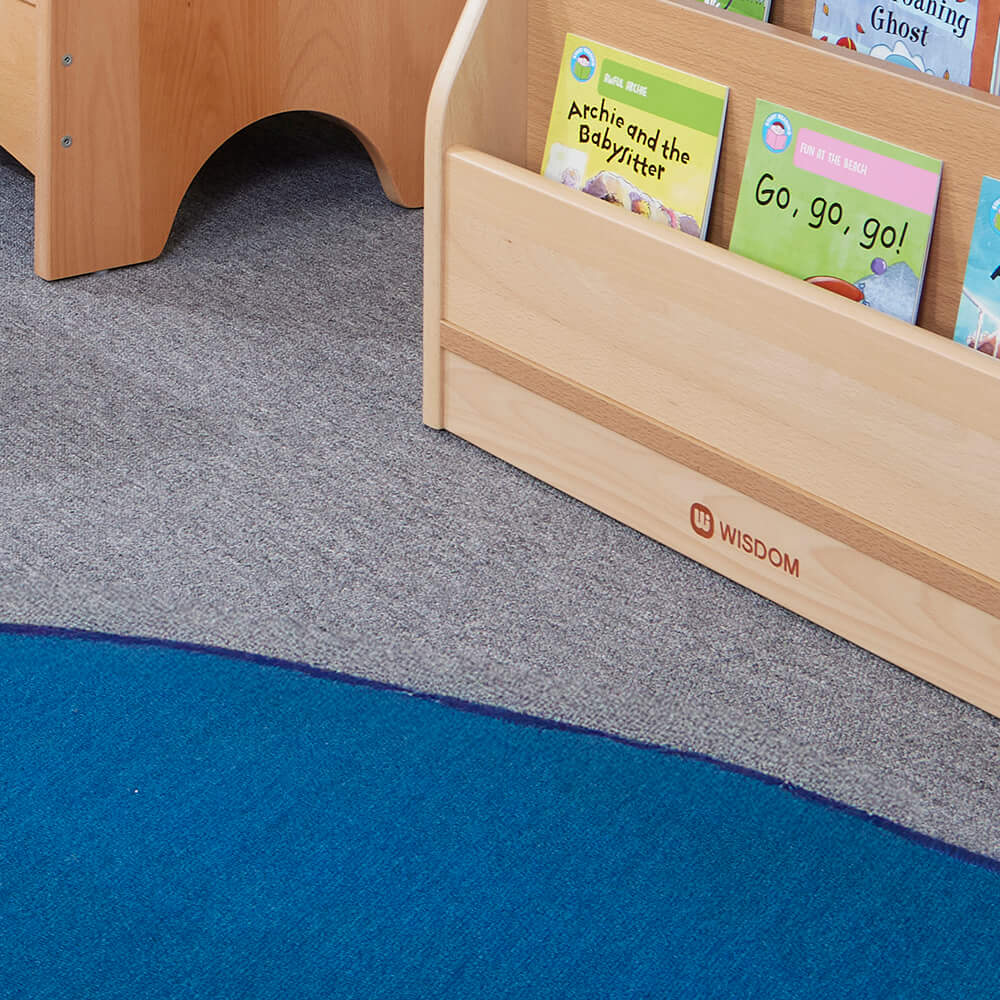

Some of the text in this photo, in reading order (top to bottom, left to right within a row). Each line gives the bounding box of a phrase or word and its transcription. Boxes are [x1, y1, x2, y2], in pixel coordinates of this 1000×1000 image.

[871, 5, 928, 46] Ghost
[568, 98, 690, 164] Archie and the
[579, 124, 665, 180] Babysitter
[800, 143, 868, 175] FUN AT THE BEACH
[755, 173, 908, 255] Go, go, go!
[720, 520, 799, 578] WISDOM
